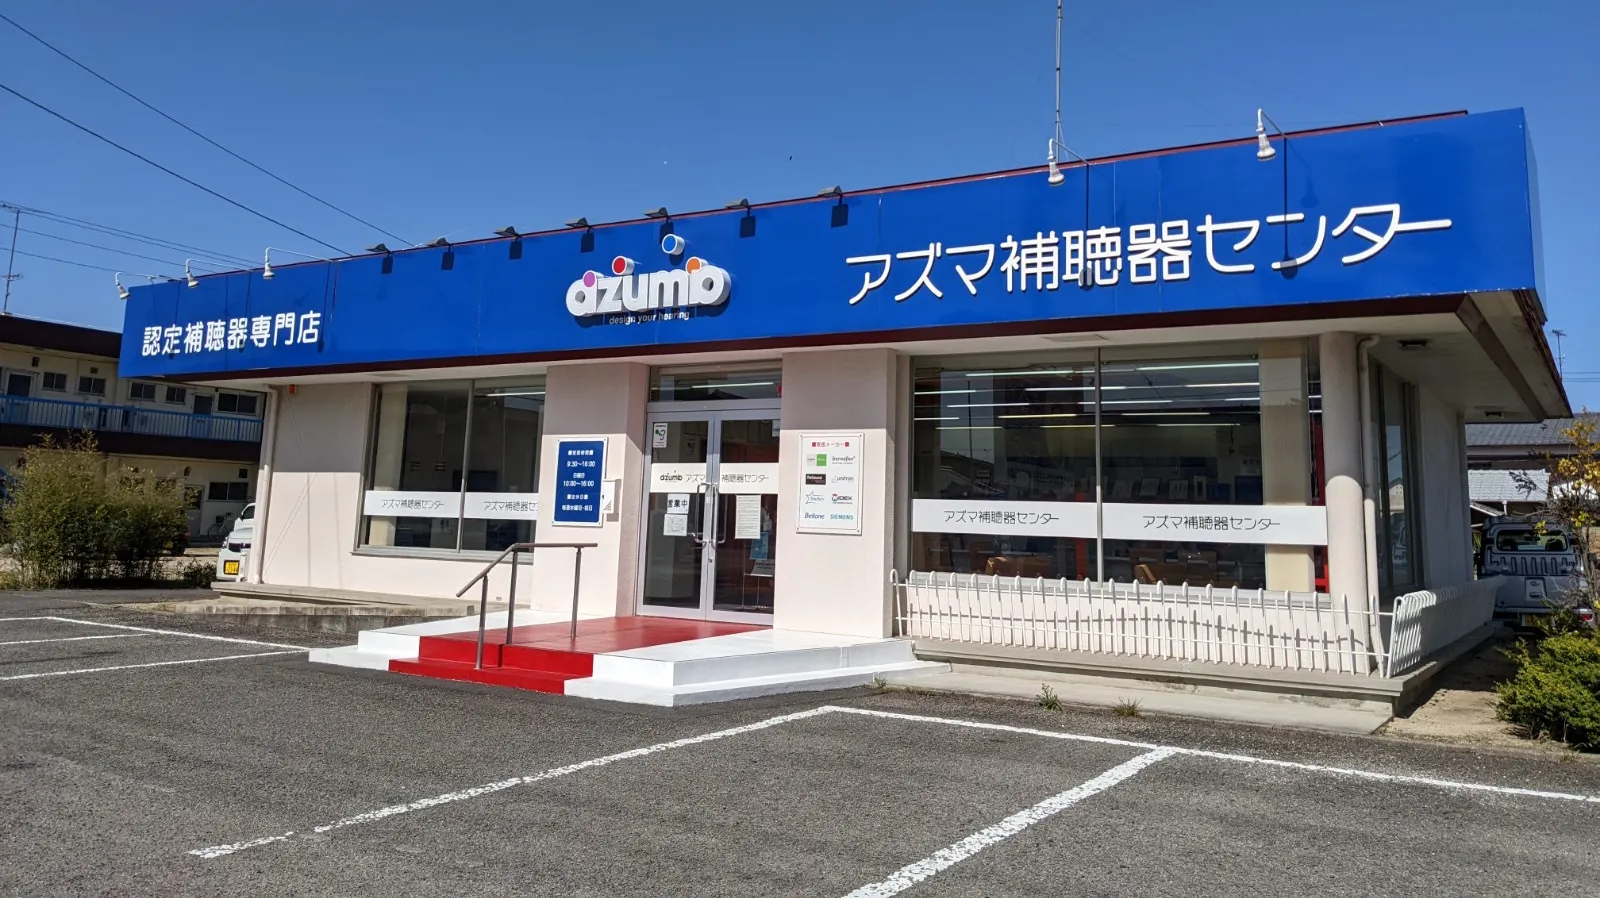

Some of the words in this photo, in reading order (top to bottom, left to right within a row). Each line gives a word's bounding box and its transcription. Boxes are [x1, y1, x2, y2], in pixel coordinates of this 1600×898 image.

[846, 203, 1452, 305] アズマ補聴器センター
[609, 314, 636, 326] design
[637, 313, 657, 325] your
[658, 311, 690, 322] hearing
[142, 310, 321, 356] 認定補聴器専門店
[685, 474, 706, 483] アズマ
[381, 499, 445, 510] アズマ補聴器センター
[667, 499, 688, 508] 営業中
[944, 510, 1059, 525] アズマ補聴器センター
[1142, 515, 1281, 532] アズマ補聴器センター
